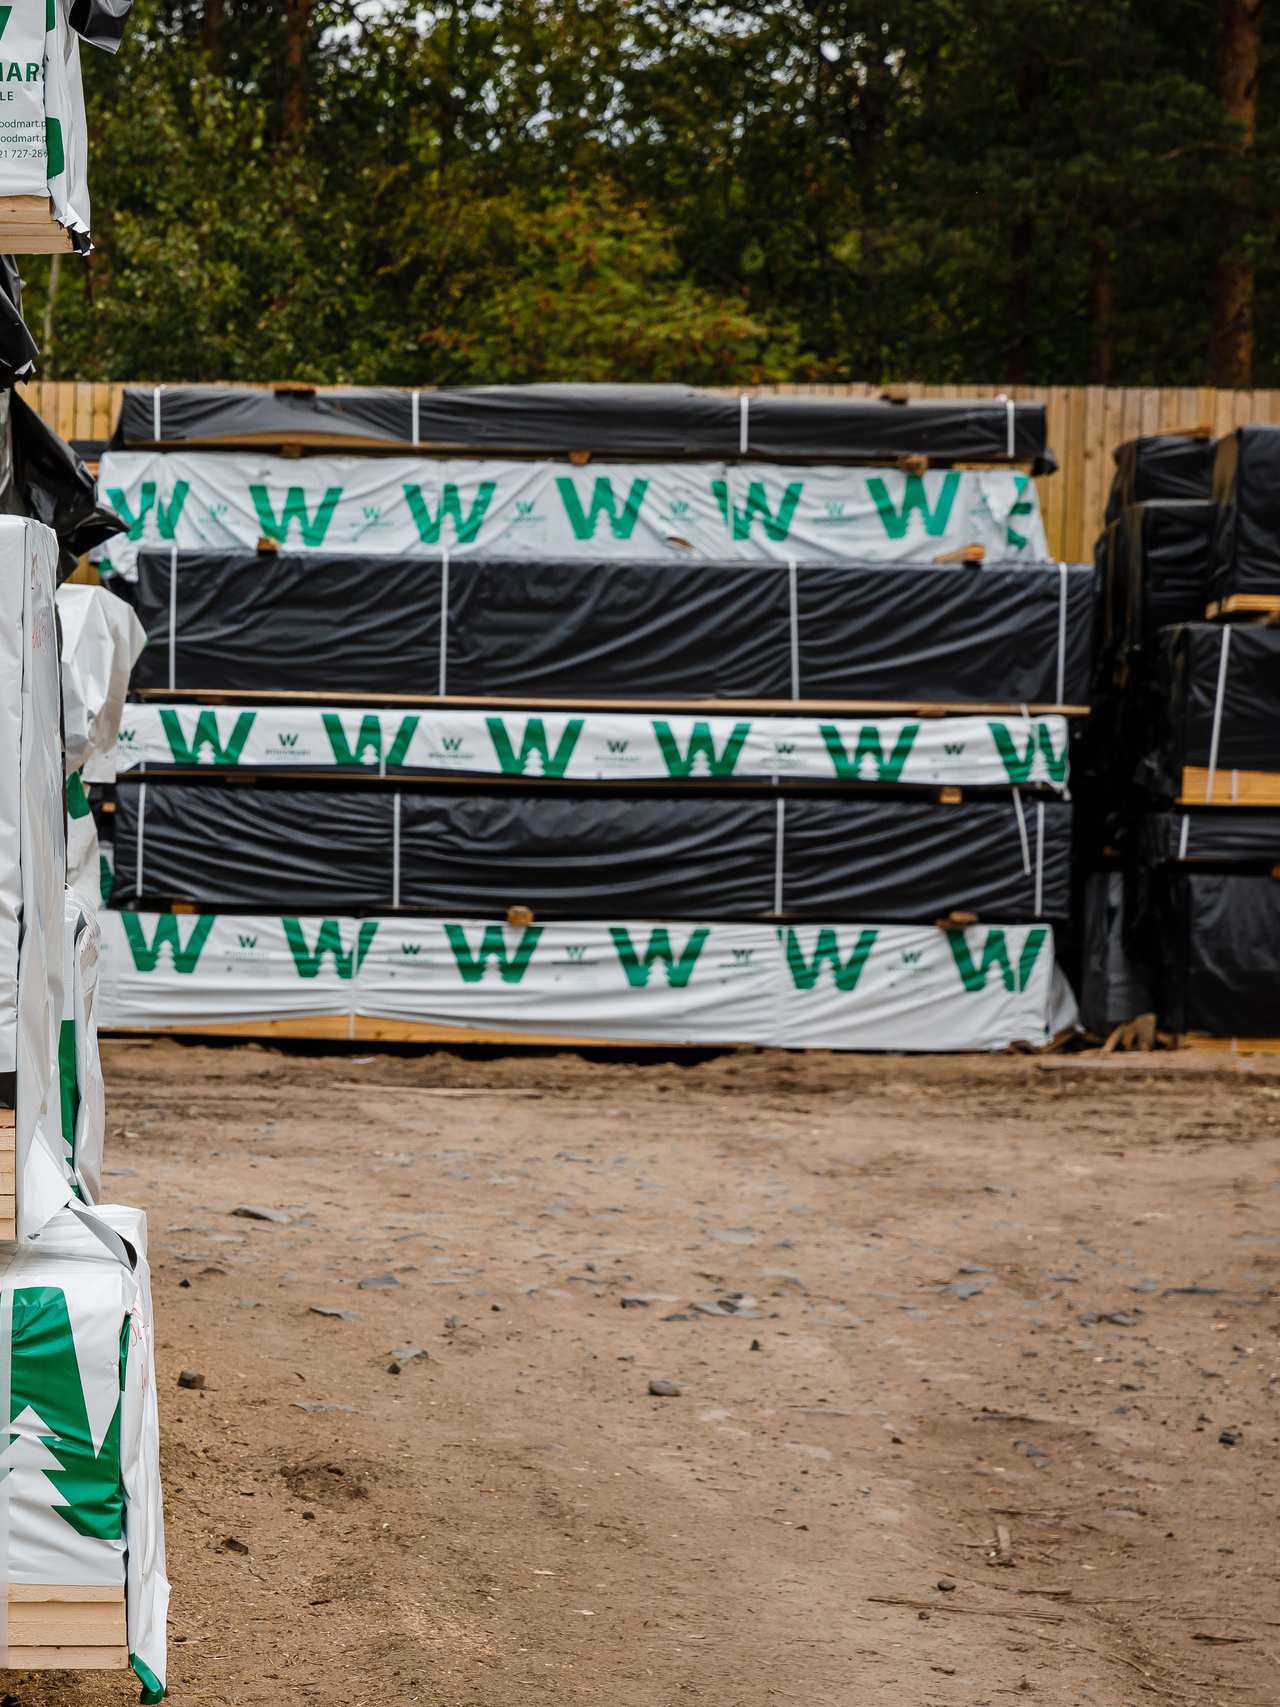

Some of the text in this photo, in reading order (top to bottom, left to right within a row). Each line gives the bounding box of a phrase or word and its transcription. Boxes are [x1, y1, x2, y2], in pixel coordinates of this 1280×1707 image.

[249, 485, 343, 547] W
[403, 482, 496, 544] W
[556, 477, 649, 540] W
[712, 480, 804, 541] W
[866, 472, 961, 539] W
[159, 710, 256, 764] W
[278, 733, 298, 747] W
[321, 714, 420, 765] W
[442, 737, 462, 750] W
[485, 717, 585, 778] W
[651, 721, 751, 777] W
[819, 725, 920, 782] W
[121, 913, 215, 973] W
[238, 934, 258, 948] W
[281, 917, 379, 978] W
[443, 923, 545, 983] W
[609, 927, 710, 987] W
[777, 926, 879, 991] W
[945, 929, 1048, 992] W
